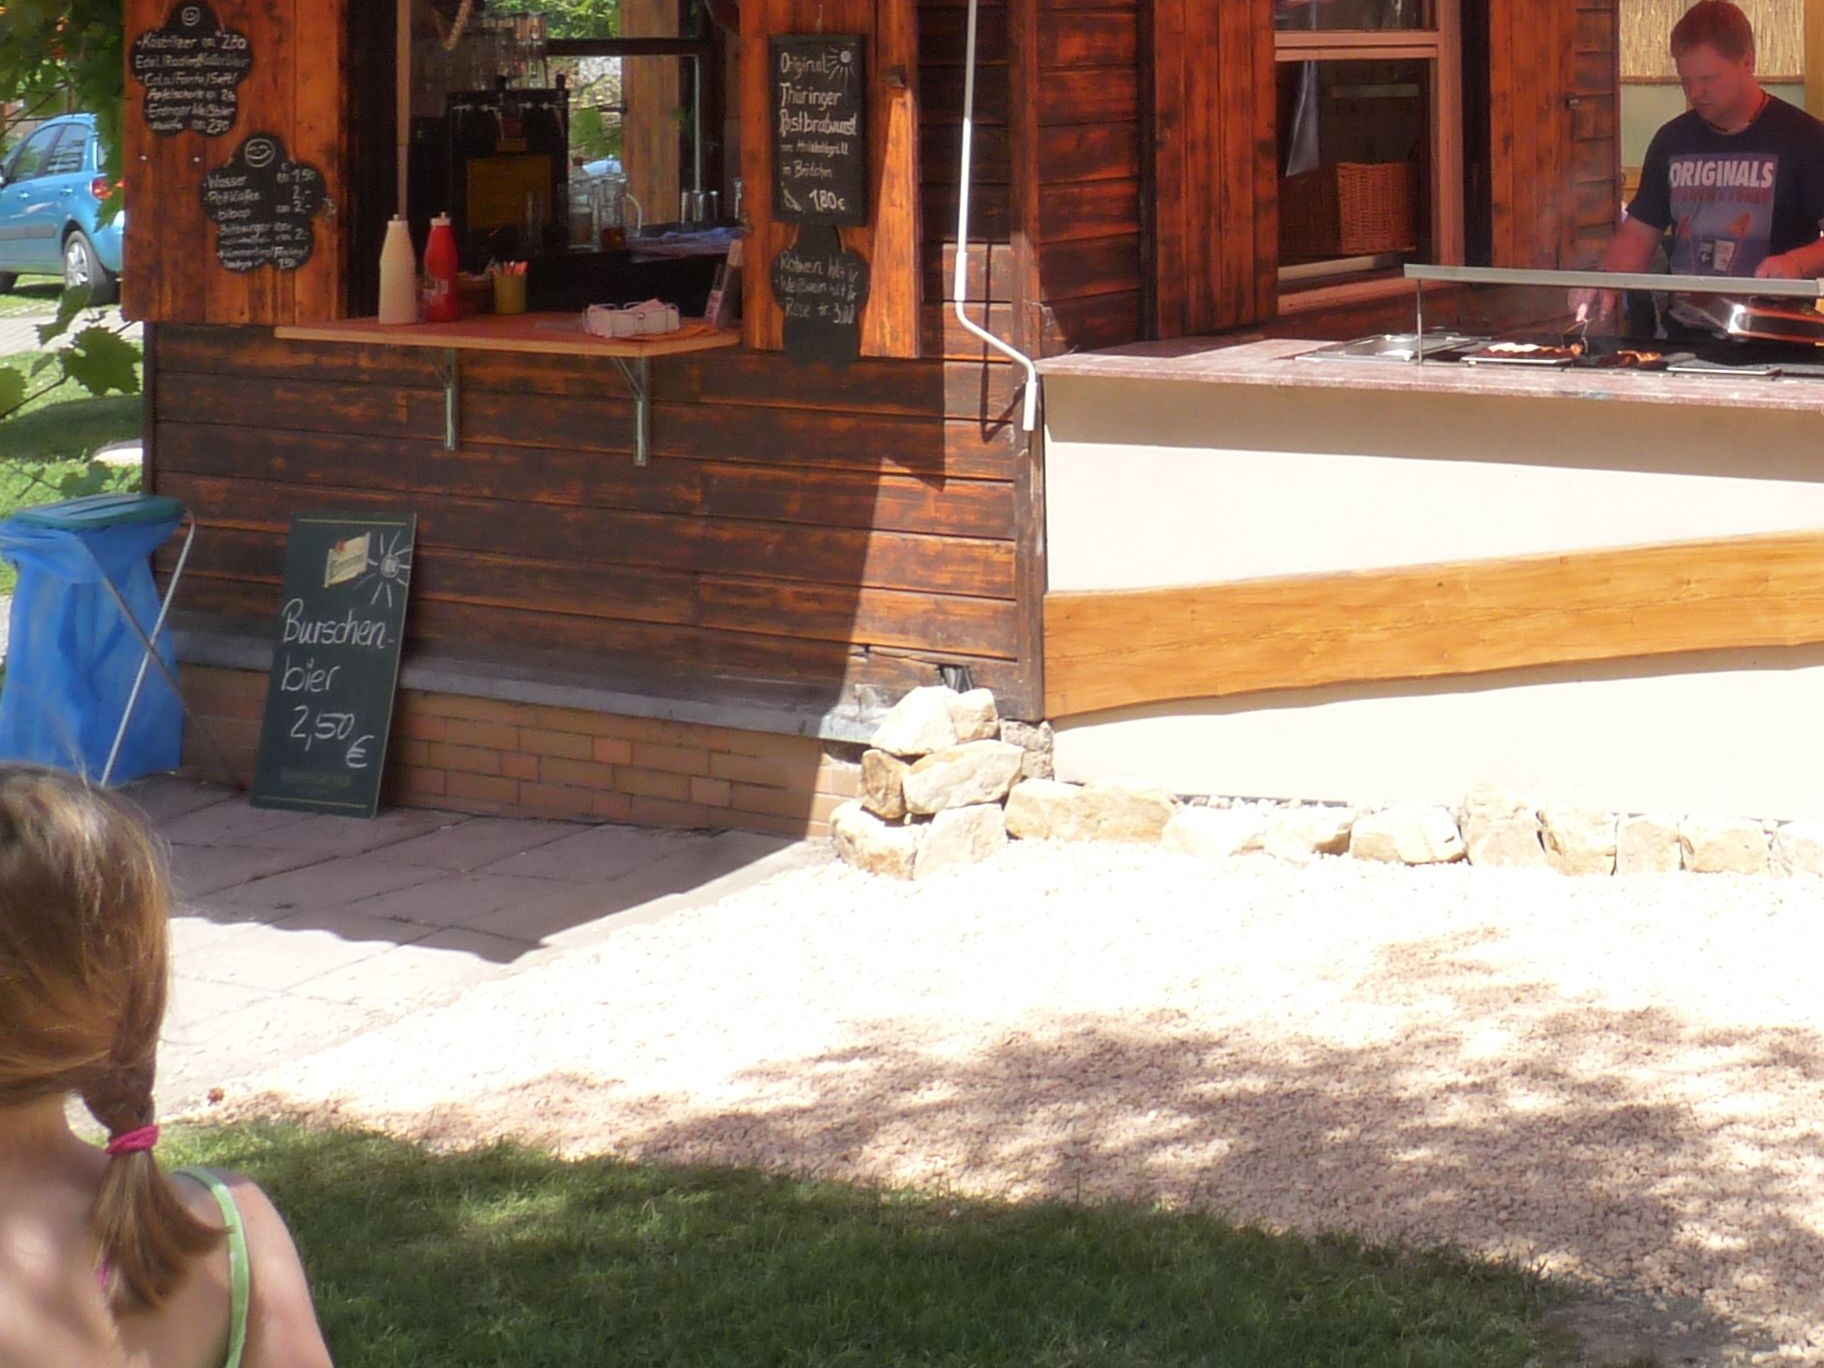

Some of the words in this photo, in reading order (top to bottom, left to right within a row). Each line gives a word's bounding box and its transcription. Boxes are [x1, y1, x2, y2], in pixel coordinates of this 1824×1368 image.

[780, 52, 829, 80] Original
[779, 82, 842, 111] Thüringer
[1669, 160, 1774, 189] ORIGINALS
[281, 656, 341, 692] bier
[289, 705, 356, 751] 2,50
